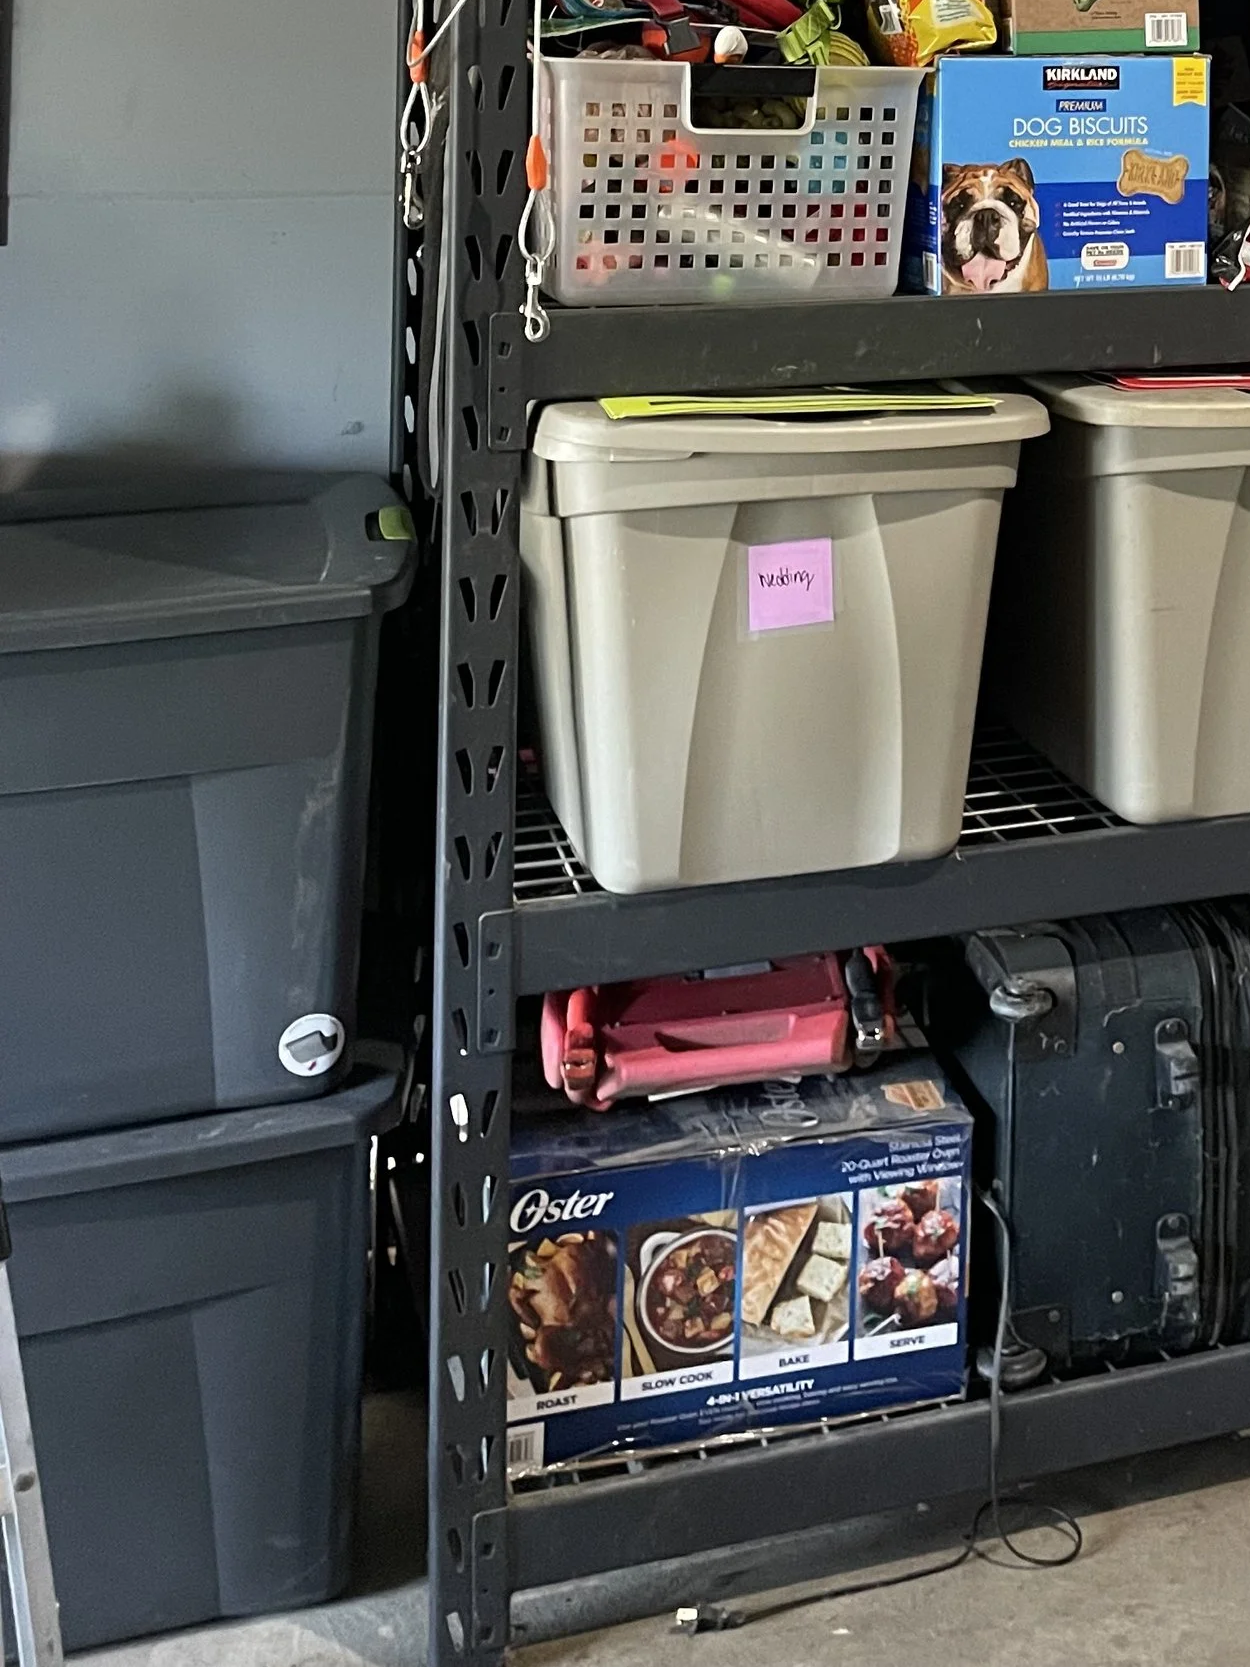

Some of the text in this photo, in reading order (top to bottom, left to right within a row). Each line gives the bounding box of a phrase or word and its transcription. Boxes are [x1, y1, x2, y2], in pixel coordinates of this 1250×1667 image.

[1045, 68, 1118, 81] KIRKLAND
[1058, 100, 1104, 112] PREMIUM
[1013, 116, 1149, 137] DOG BISCUITS
[1008, 139, 1048, 148] CHICKEN
[1050, 139, 1074, 147] MEAL
[1086, 138, 1105, 147] RICE
[1106, 137, 1149, 146] FORMULA
[509, 1188, 615, 1233] Oster
[889, 1334, 925, 1349] SERVE
[778, 1354, 810, 1368] BAKE
[641, 1370, 714, 1392] SLOW COOK
[536, 1394, 577, 1411] ROAST
